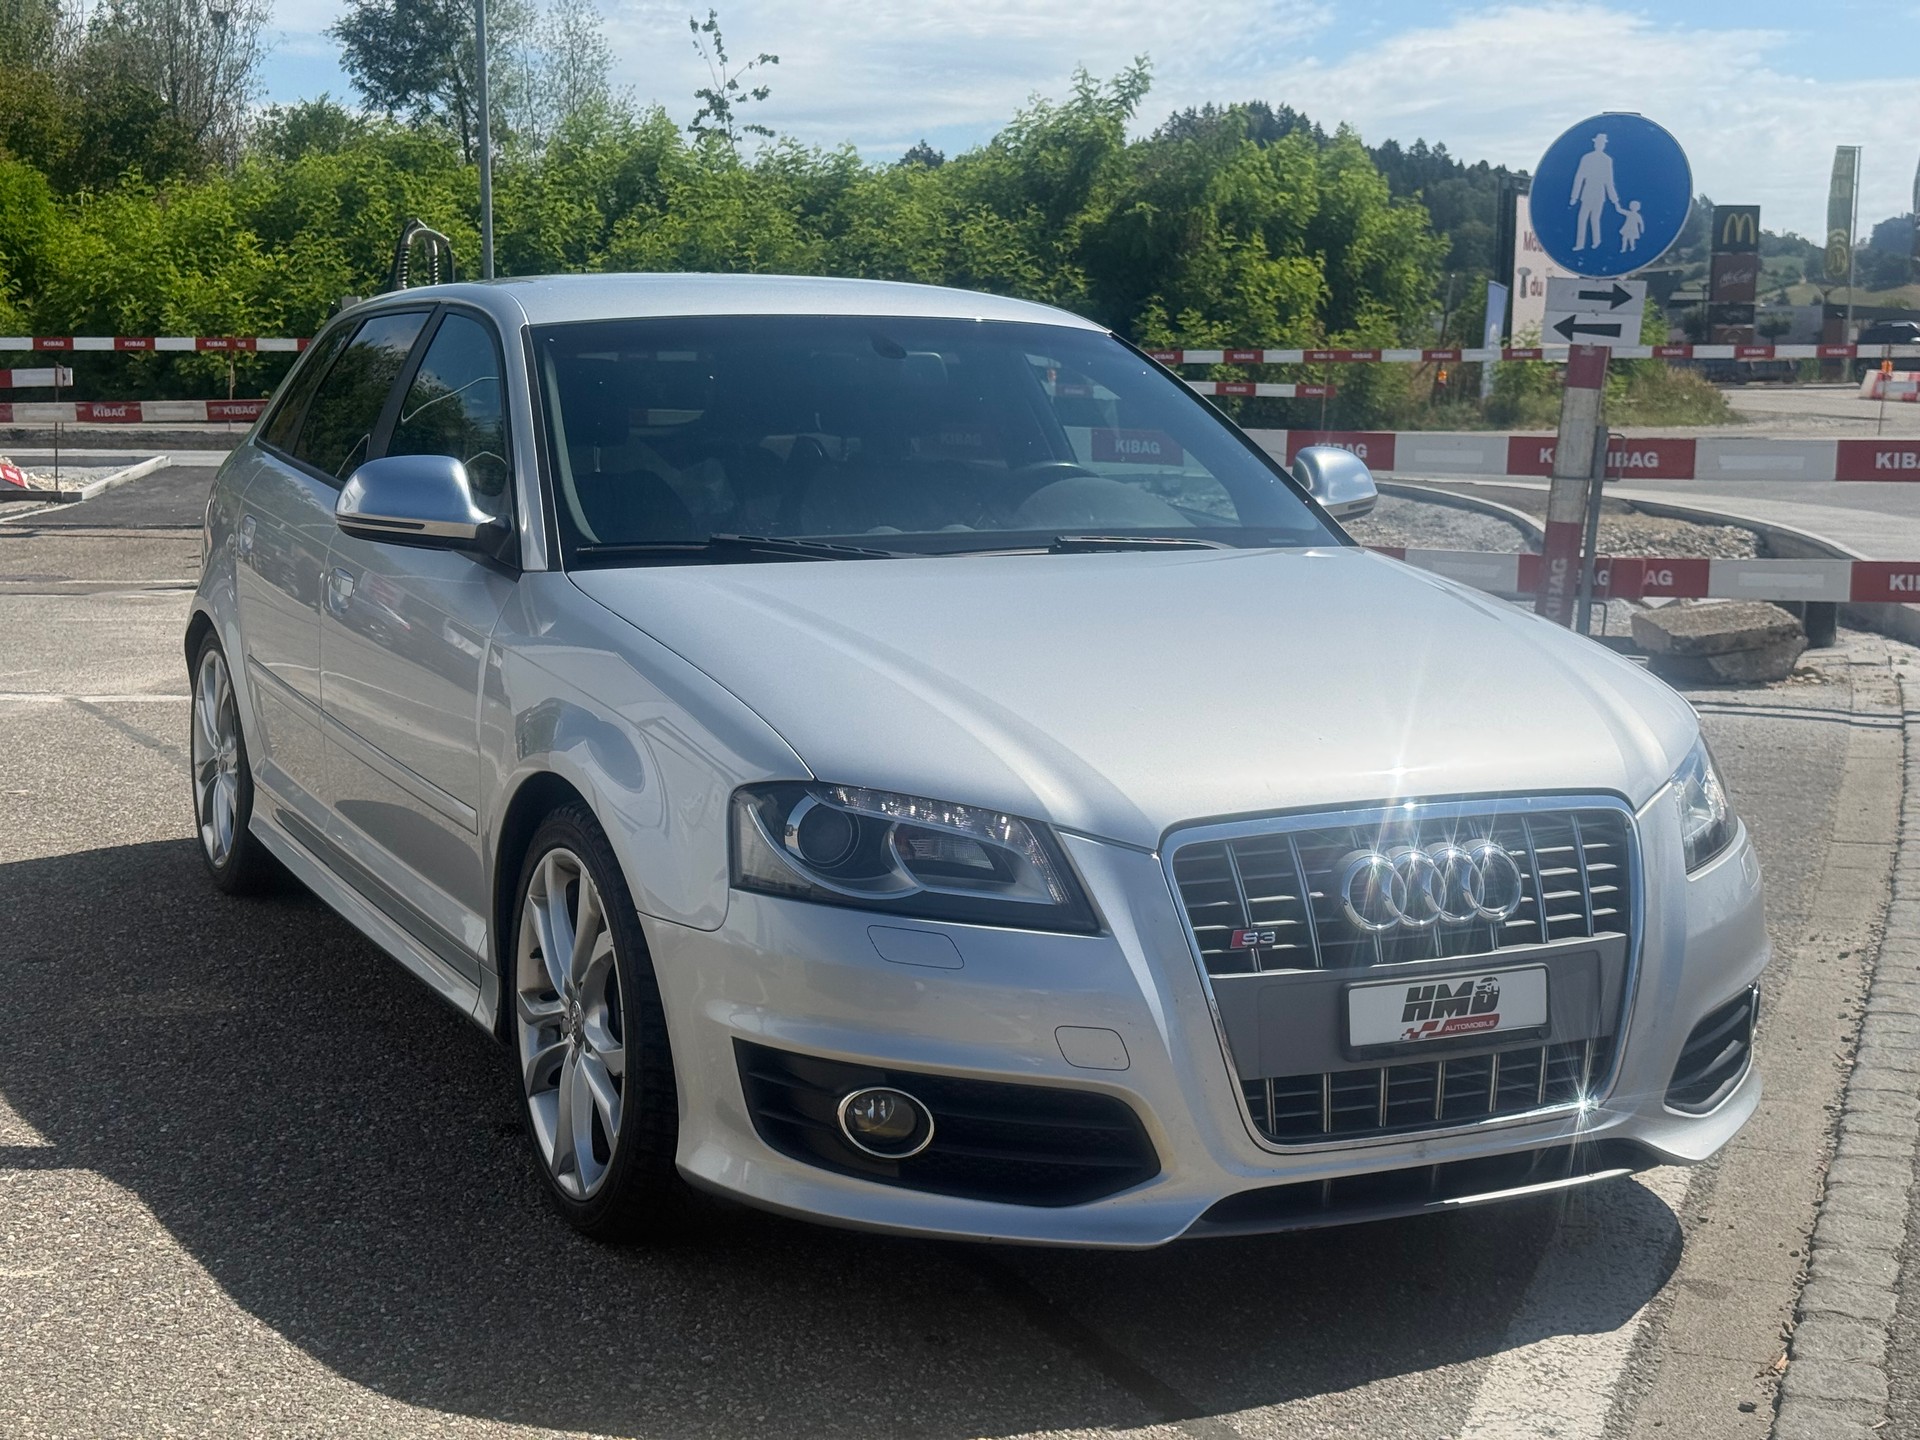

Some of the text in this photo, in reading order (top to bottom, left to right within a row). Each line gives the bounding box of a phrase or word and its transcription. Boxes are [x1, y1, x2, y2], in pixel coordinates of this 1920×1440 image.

[93, 406, 126, 417] KIBAG
[223, 405, 257, 416] KIBAG
[1115, 438, 1160, 455] KIBAG
[1608, 452, 1659, 467] IBAG
[1875, 452, 1920, 469] KIB
[1242, 931, 1275, 946] S3
[1445, 1020, 1495, 1032] AUTOMOBILE
